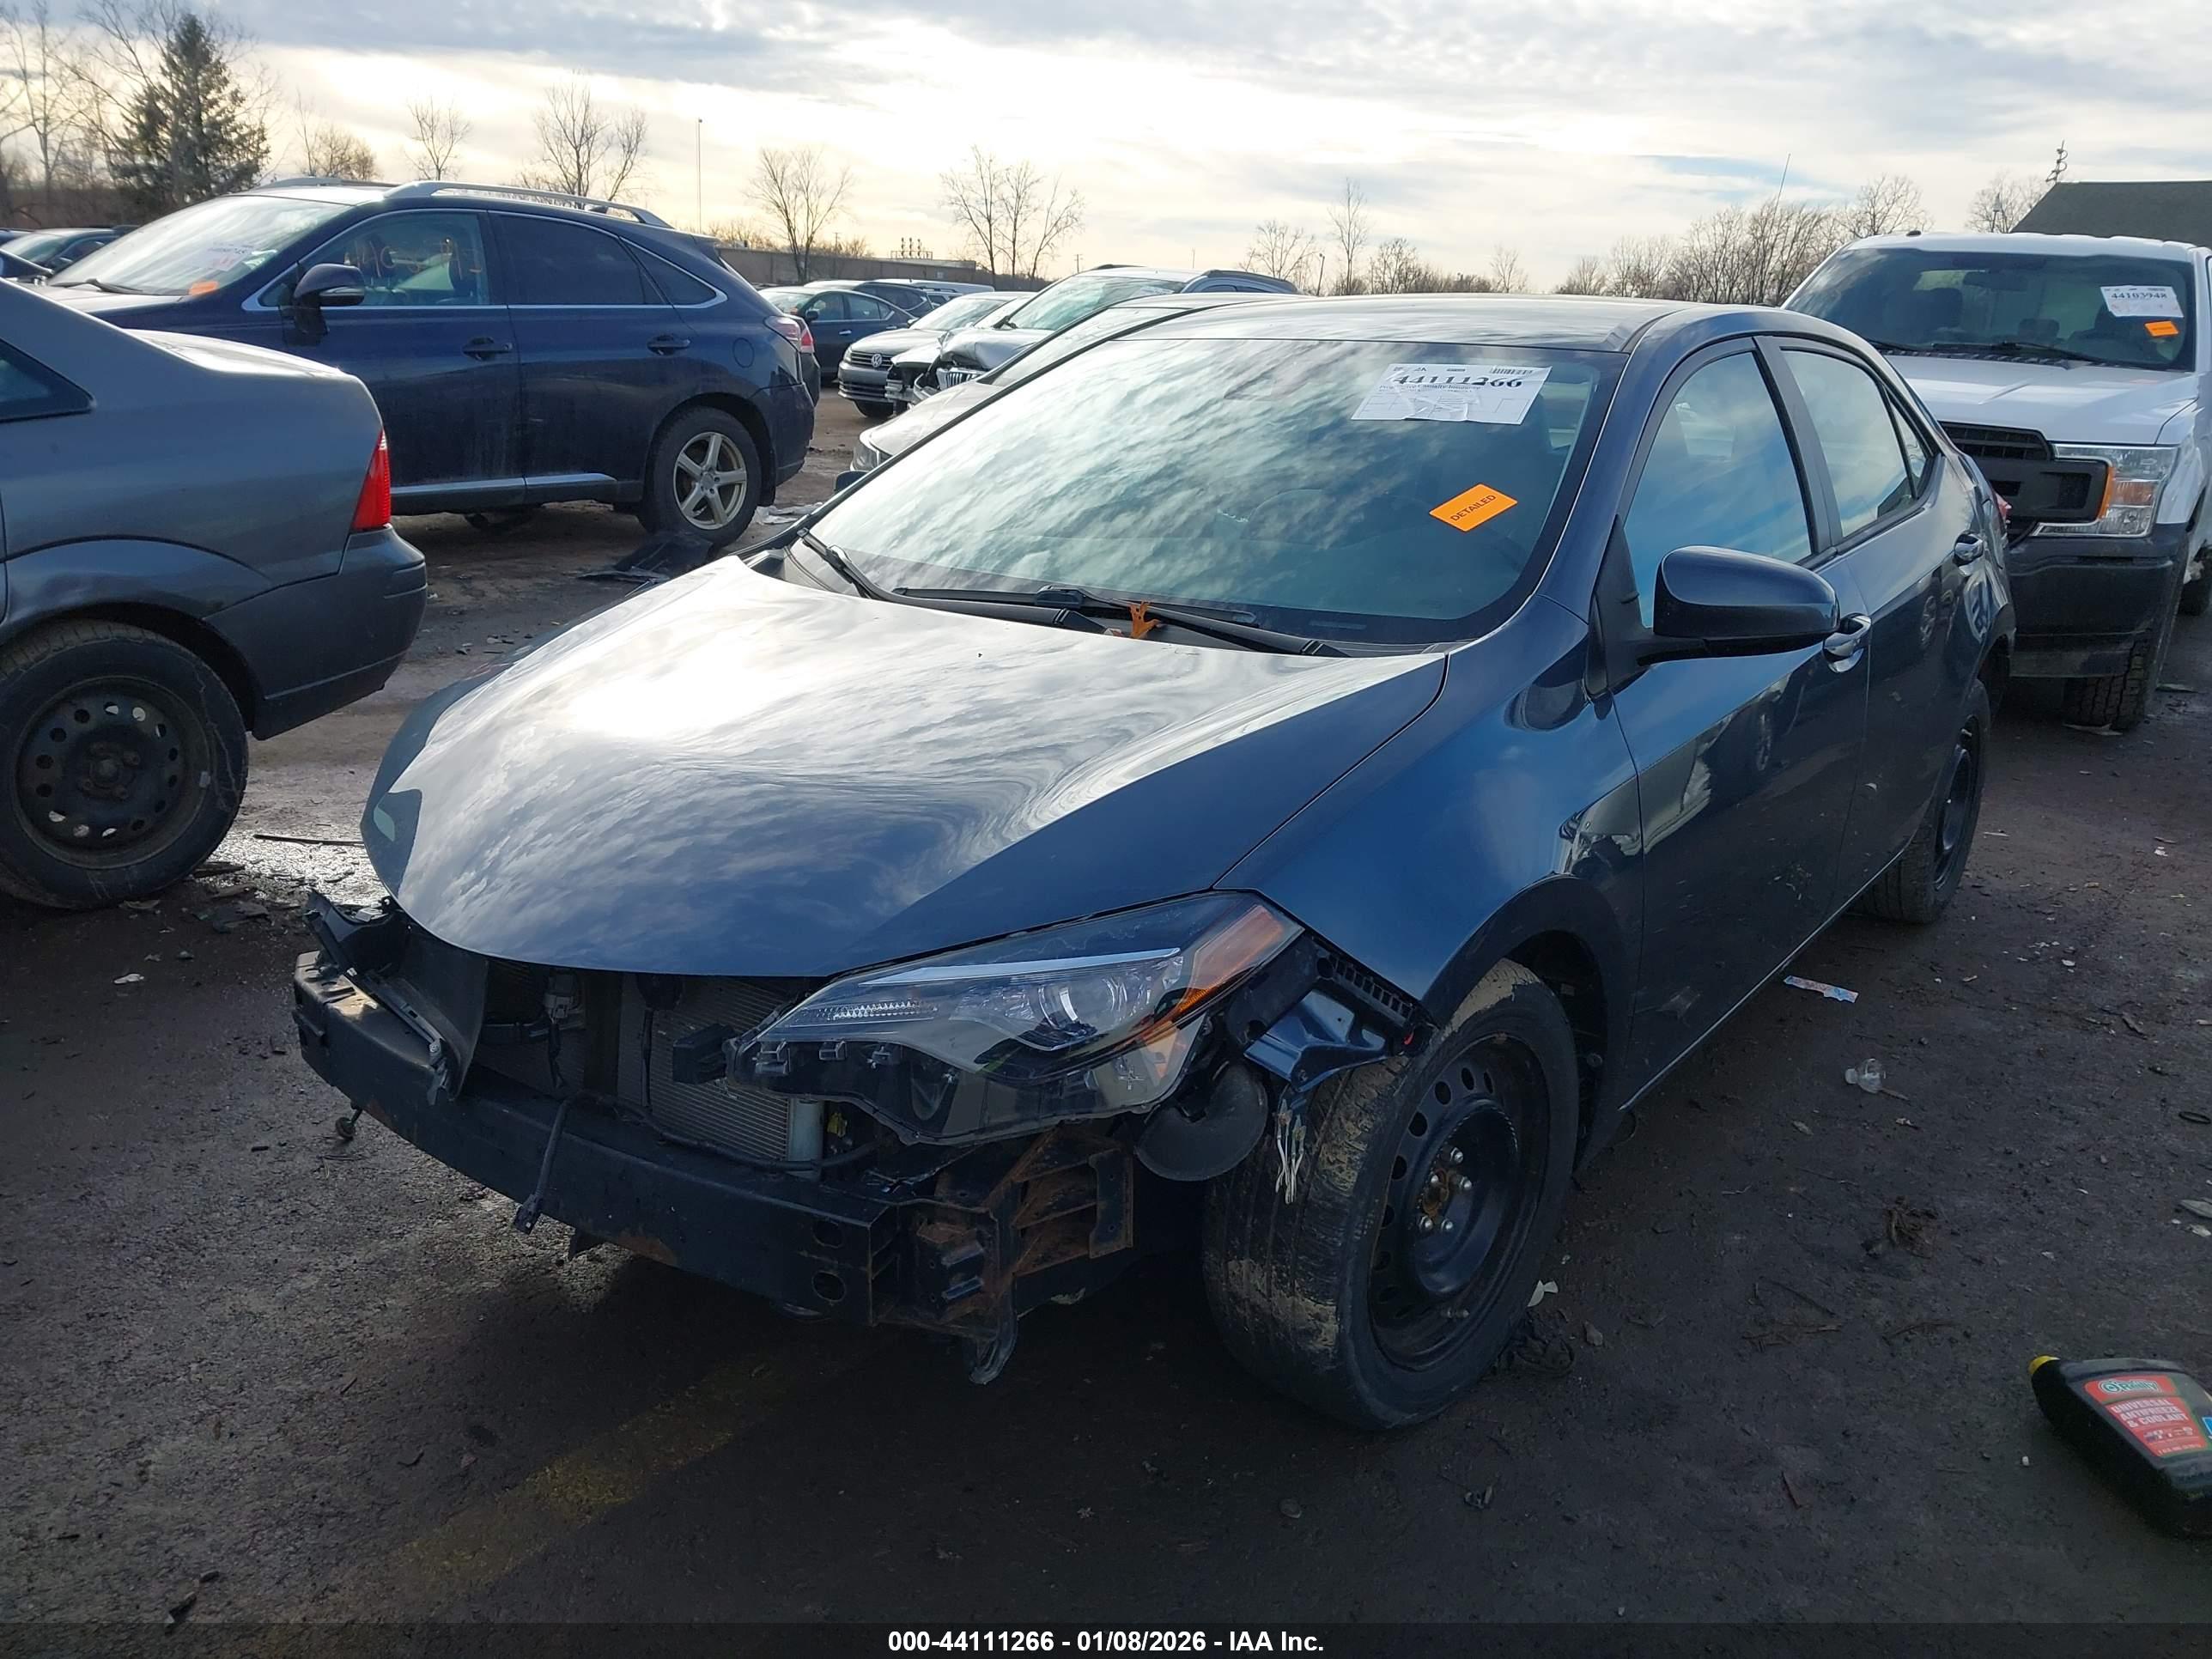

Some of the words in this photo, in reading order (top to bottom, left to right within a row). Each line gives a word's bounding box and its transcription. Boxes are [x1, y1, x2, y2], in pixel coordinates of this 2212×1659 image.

[1393, 375, 1522, 387] 44111266
[1449, 495, 1497, 521] DETAILED
[2111, 1399, 2174, 1413] UNIVERSAL
[2120, 1407, 2183, 1420] ANTIFREEZE
[2138, 1413, 2189, 1425] COOLANT
